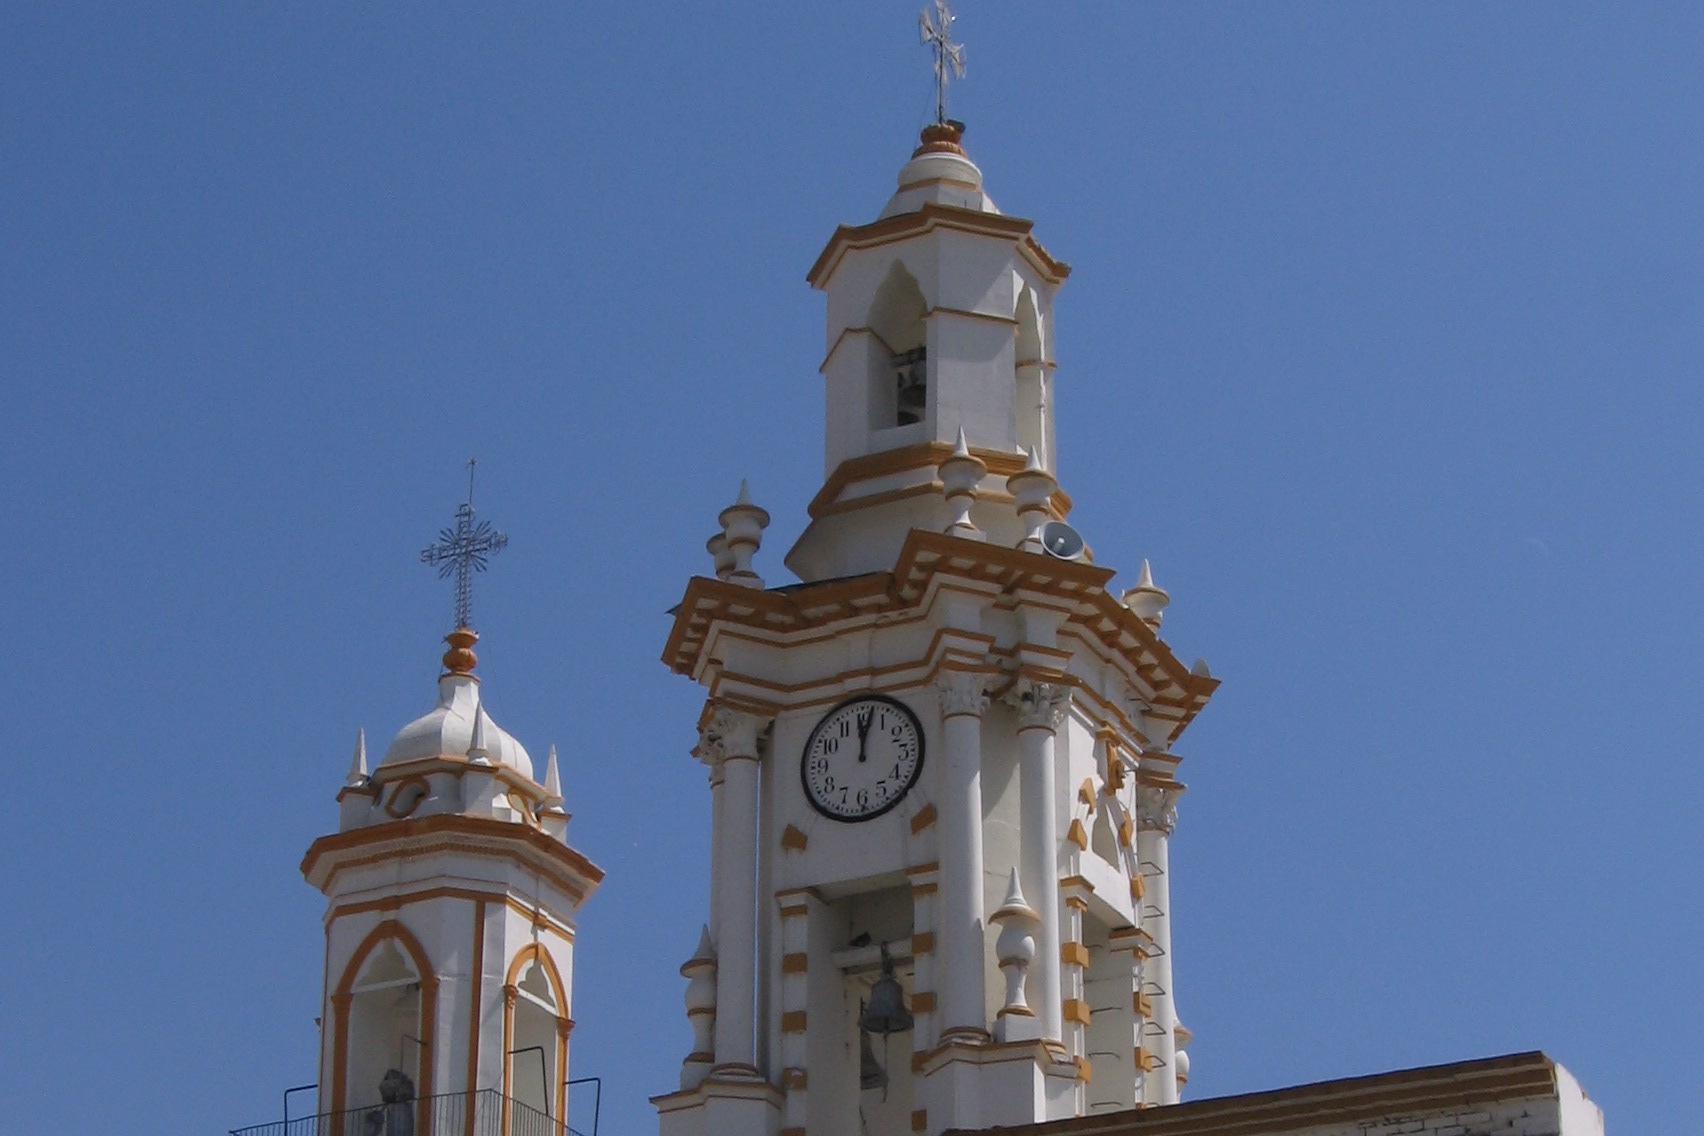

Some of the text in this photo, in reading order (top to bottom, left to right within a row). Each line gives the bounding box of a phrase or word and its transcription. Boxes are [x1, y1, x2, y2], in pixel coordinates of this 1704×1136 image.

[840, 720, 849, 737] 11
[891, 725, 902, 744] 2
[824, 737, 838, 755] 10
[898, 743, 909, 761] 3
[818, 758, 828, 775] 9
[889, 763, 901, 780] 4
[824, 777, 834, 793] 8
[876, 780, 886, 797] 5
[840, 787, 848, 804] 7
[857, 789, 868, 807] 6
